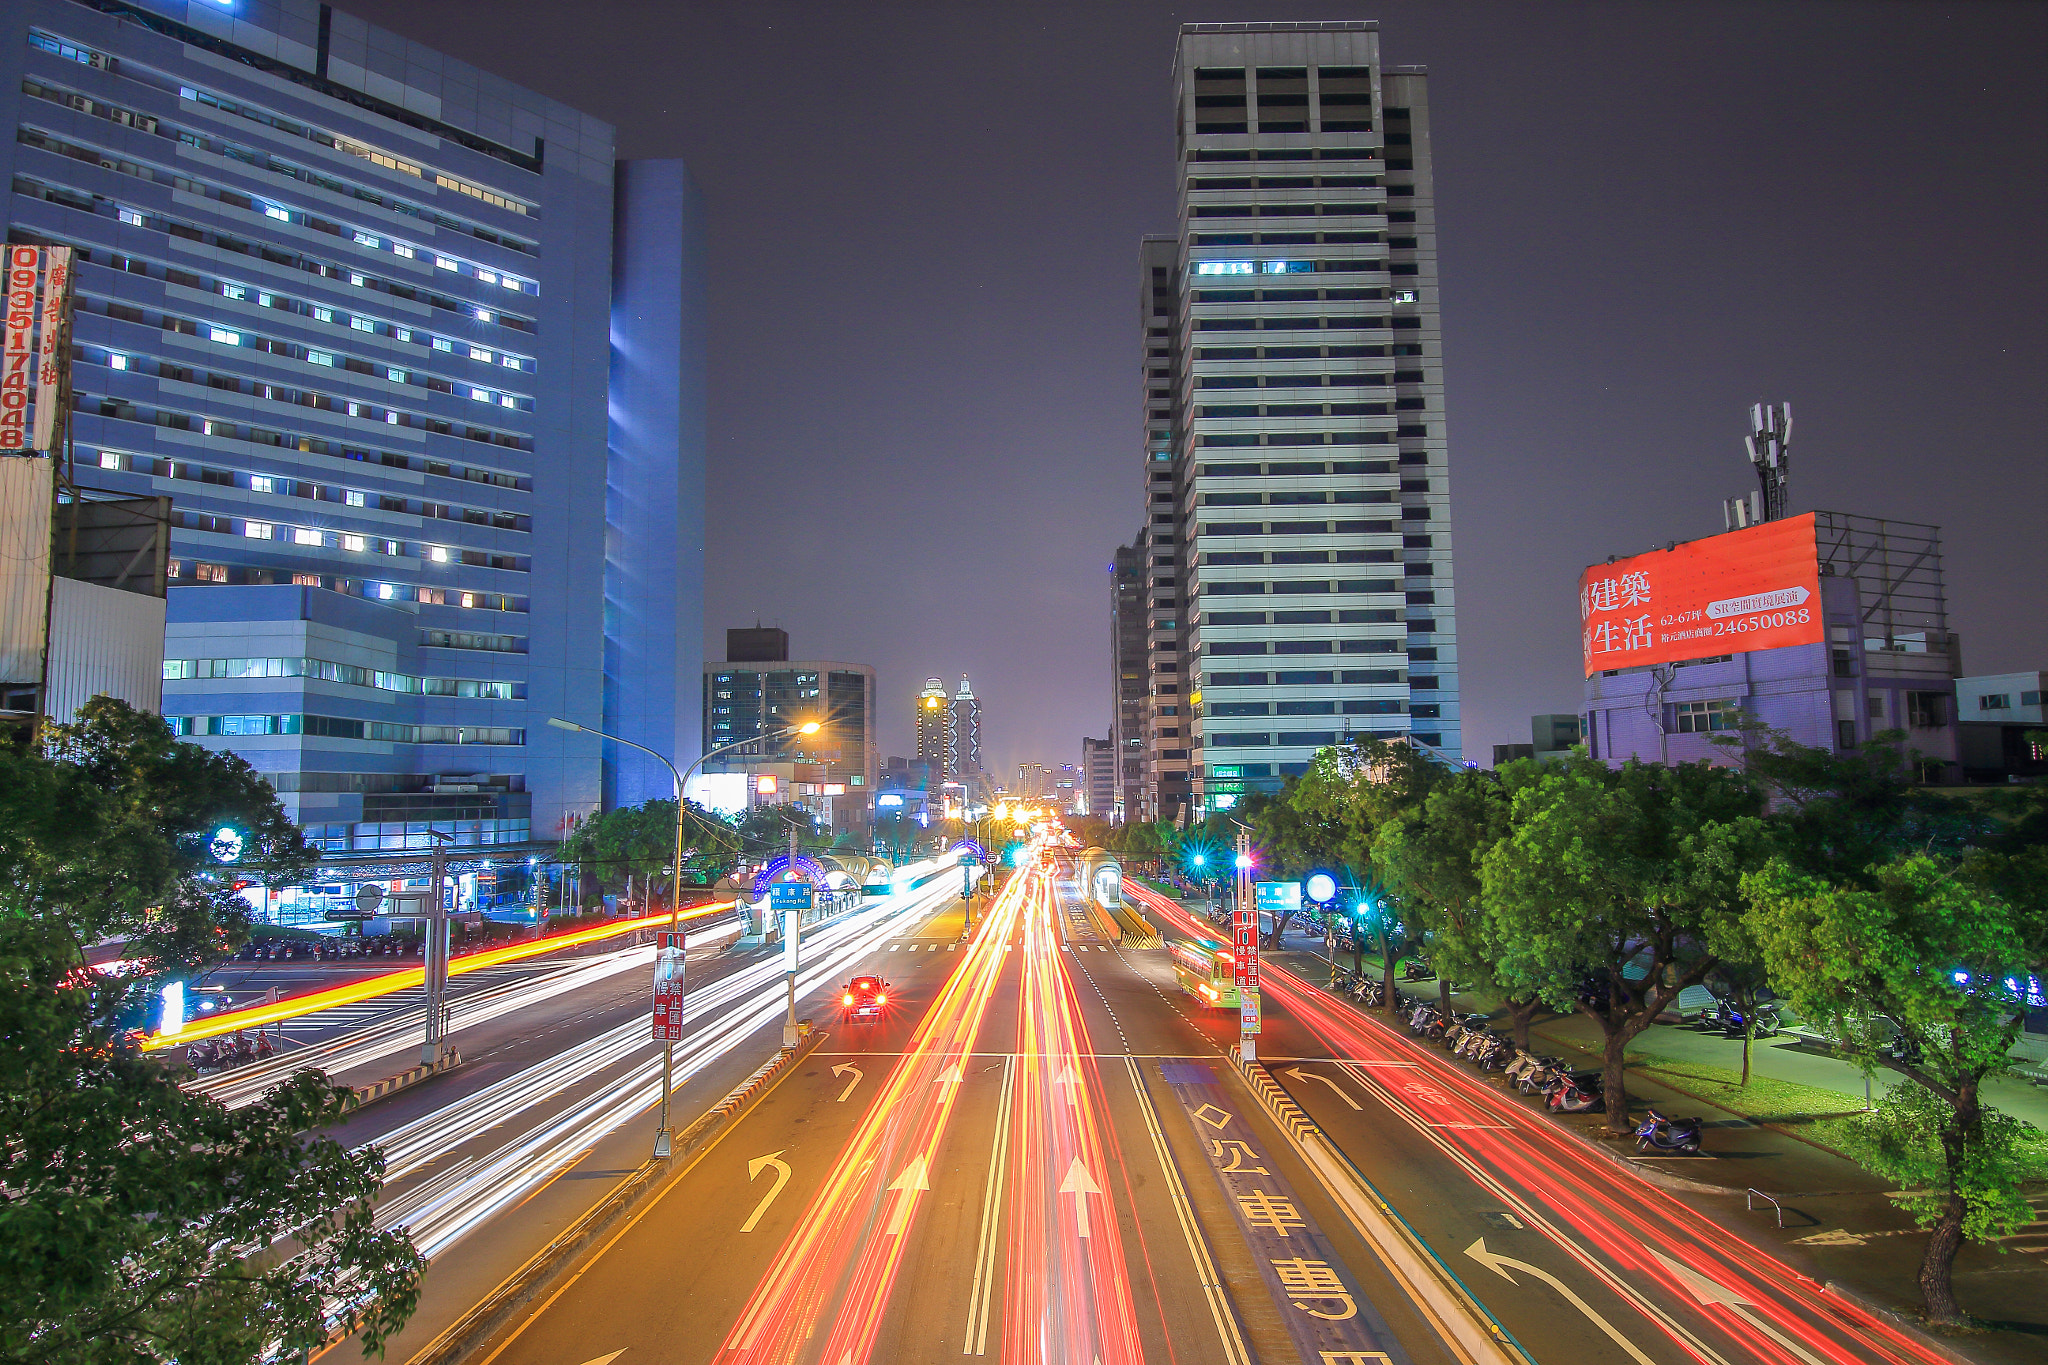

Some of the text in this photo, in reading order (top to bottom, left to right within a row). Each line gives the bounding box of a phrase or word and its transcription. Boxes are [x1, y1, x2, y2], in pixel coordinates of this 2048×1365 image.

[0, 247, 38, 448] 0935174048
[1590, 570, 1652, 614] 建築
[1593, 613, 1653, 654] 生活
[1714, 608, 1810, 637] 24650088
[772, 887, 810, 896] 福康路
[1236, 945, 1246, 986] 慢車道
[1247, 945, 1257, 986] 禁止匯出
[654, 981, 668, 1039] 慢車道
[668, 981, 682, 1039] 禁止匯出
